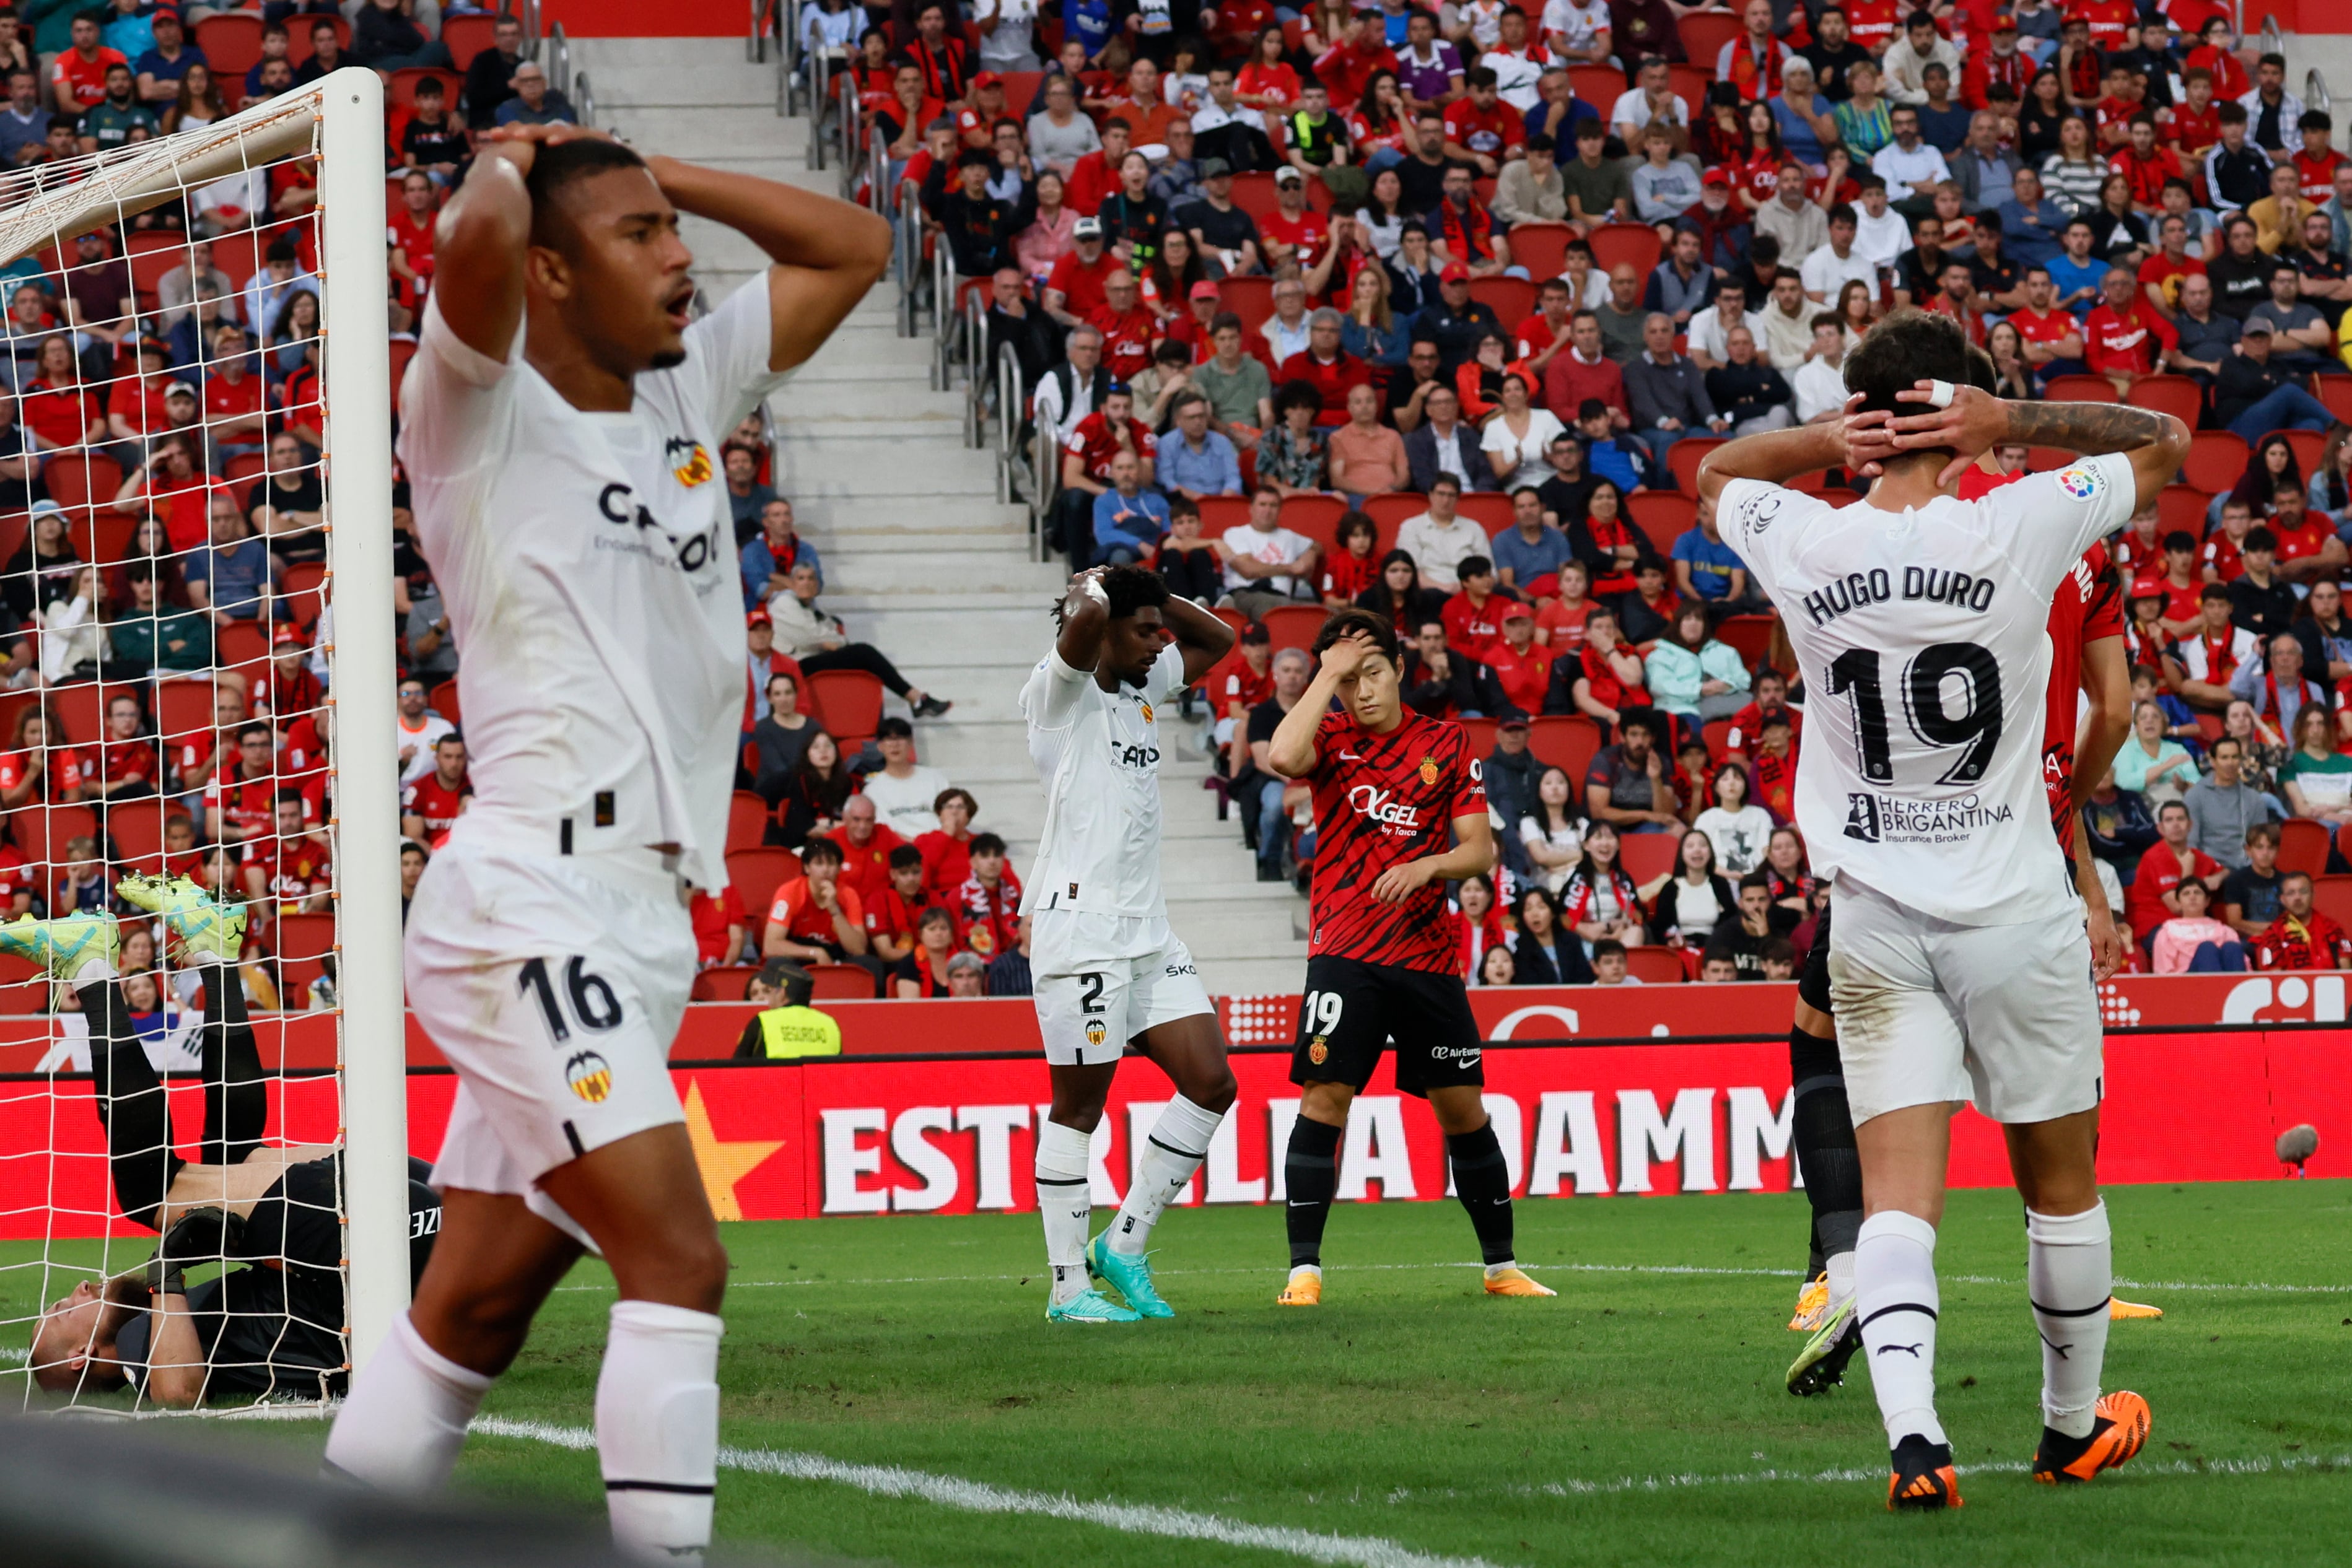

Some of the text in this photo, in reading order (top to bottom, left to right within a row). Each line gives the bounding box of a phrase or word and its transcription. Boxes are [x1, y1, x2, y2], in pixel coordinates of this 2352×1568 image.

[1802, 566, 1996, 628] HUGO DURO
[1825, 642, 2004, 786] 19
[1879, 794, 1979, 814] HERRERO
[1882, 804, 2014, 832] BRIGANTINA
[1381, 824, 1417, 836] by Taica
[1885, 834, 1971, 843] Insurance Broker
[515, 954, 623, 1049] 16
[1078, 972, 1106, 1016] 2
[1305, 990, 1343, 1037] 19
[780, 1026, 827, 1043] SEGURIDAD
